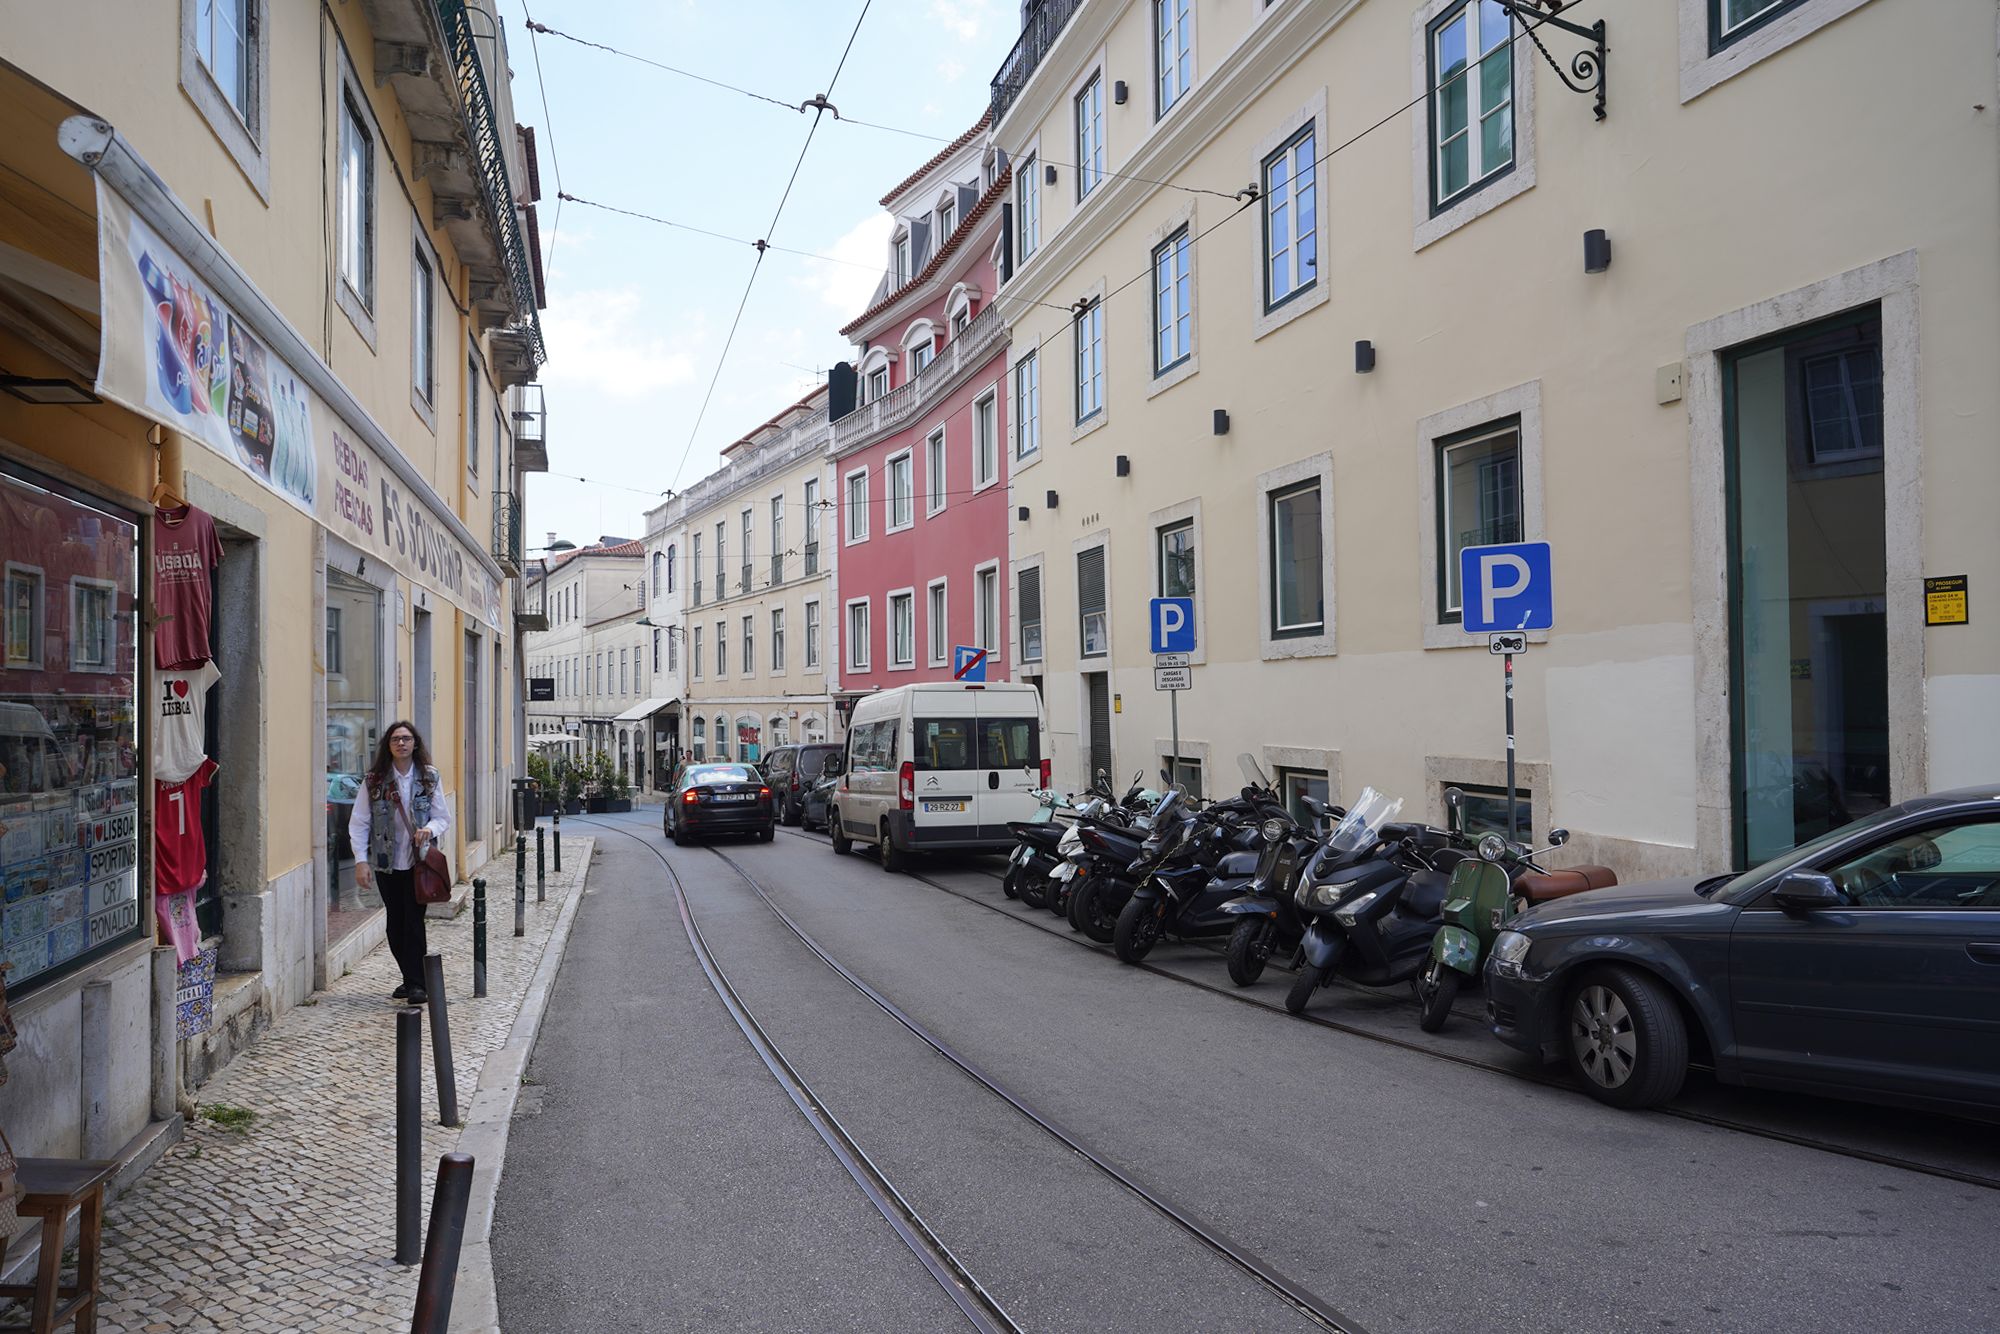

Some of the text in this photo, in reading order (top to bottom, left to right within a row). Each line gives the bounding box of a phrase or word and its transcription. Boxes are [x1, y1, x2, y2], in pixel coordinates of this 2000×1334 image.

[333, 431, 369, 491] BEBIDAS
[334, 479, 374, 536] FRESCAS
[381, 477, 463, 597] FS SOUVENIR
[156, 552, 203, 573] LISBOA
[1480, 553, 1532, 624] P
[1160, 603, 1185, 648] P
[162, 701, 191, 717] LISBOA
[163, 681, 173, 701] I
[103, 815, 134, 842] LISBOA
[91, 844, 136, 878] SPORTING
[103, 877, 122, 906] CR7
[91, 904, 136, 944] RONALDO
